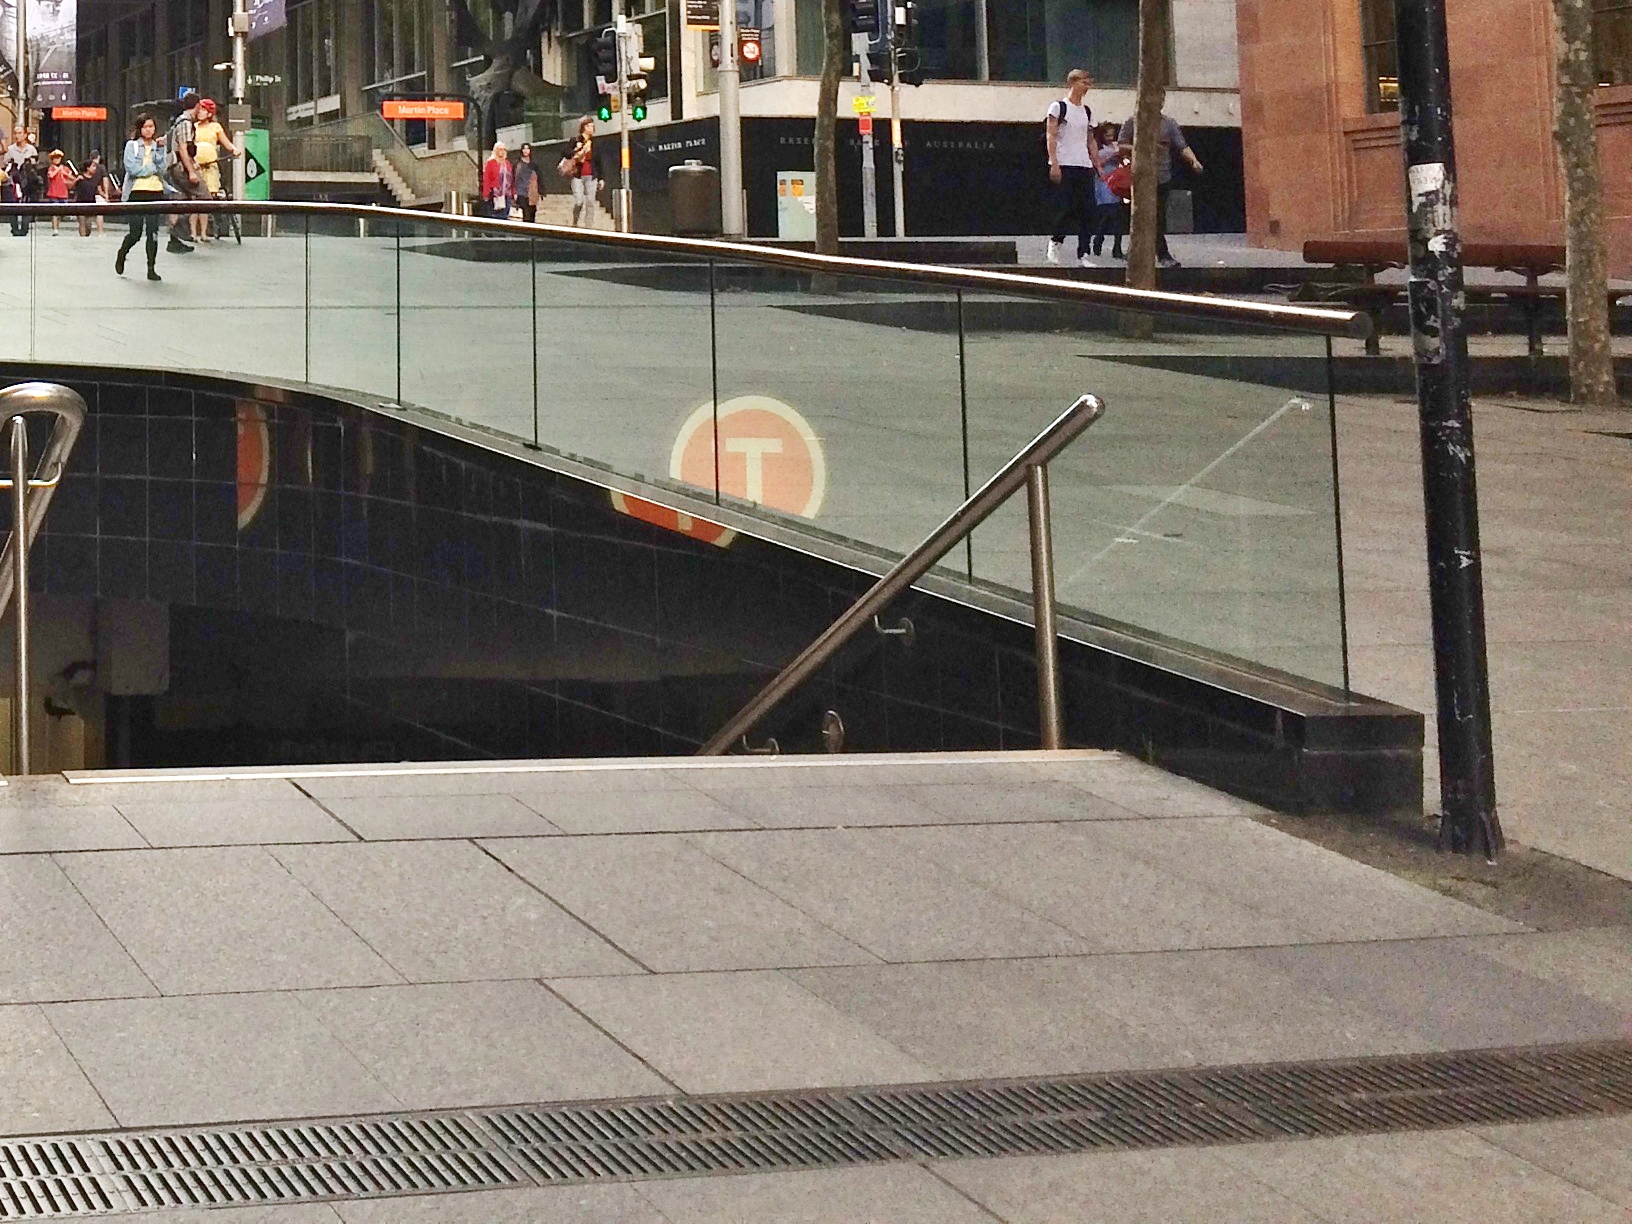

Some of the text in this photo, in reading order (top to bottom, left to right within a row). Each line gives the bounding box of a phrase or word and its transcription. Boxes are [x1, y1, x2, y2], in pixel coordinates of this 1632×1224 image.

[398, 105, 449, 115] Martin Place
[926, 140, 996, 149] AUSTRALIA
